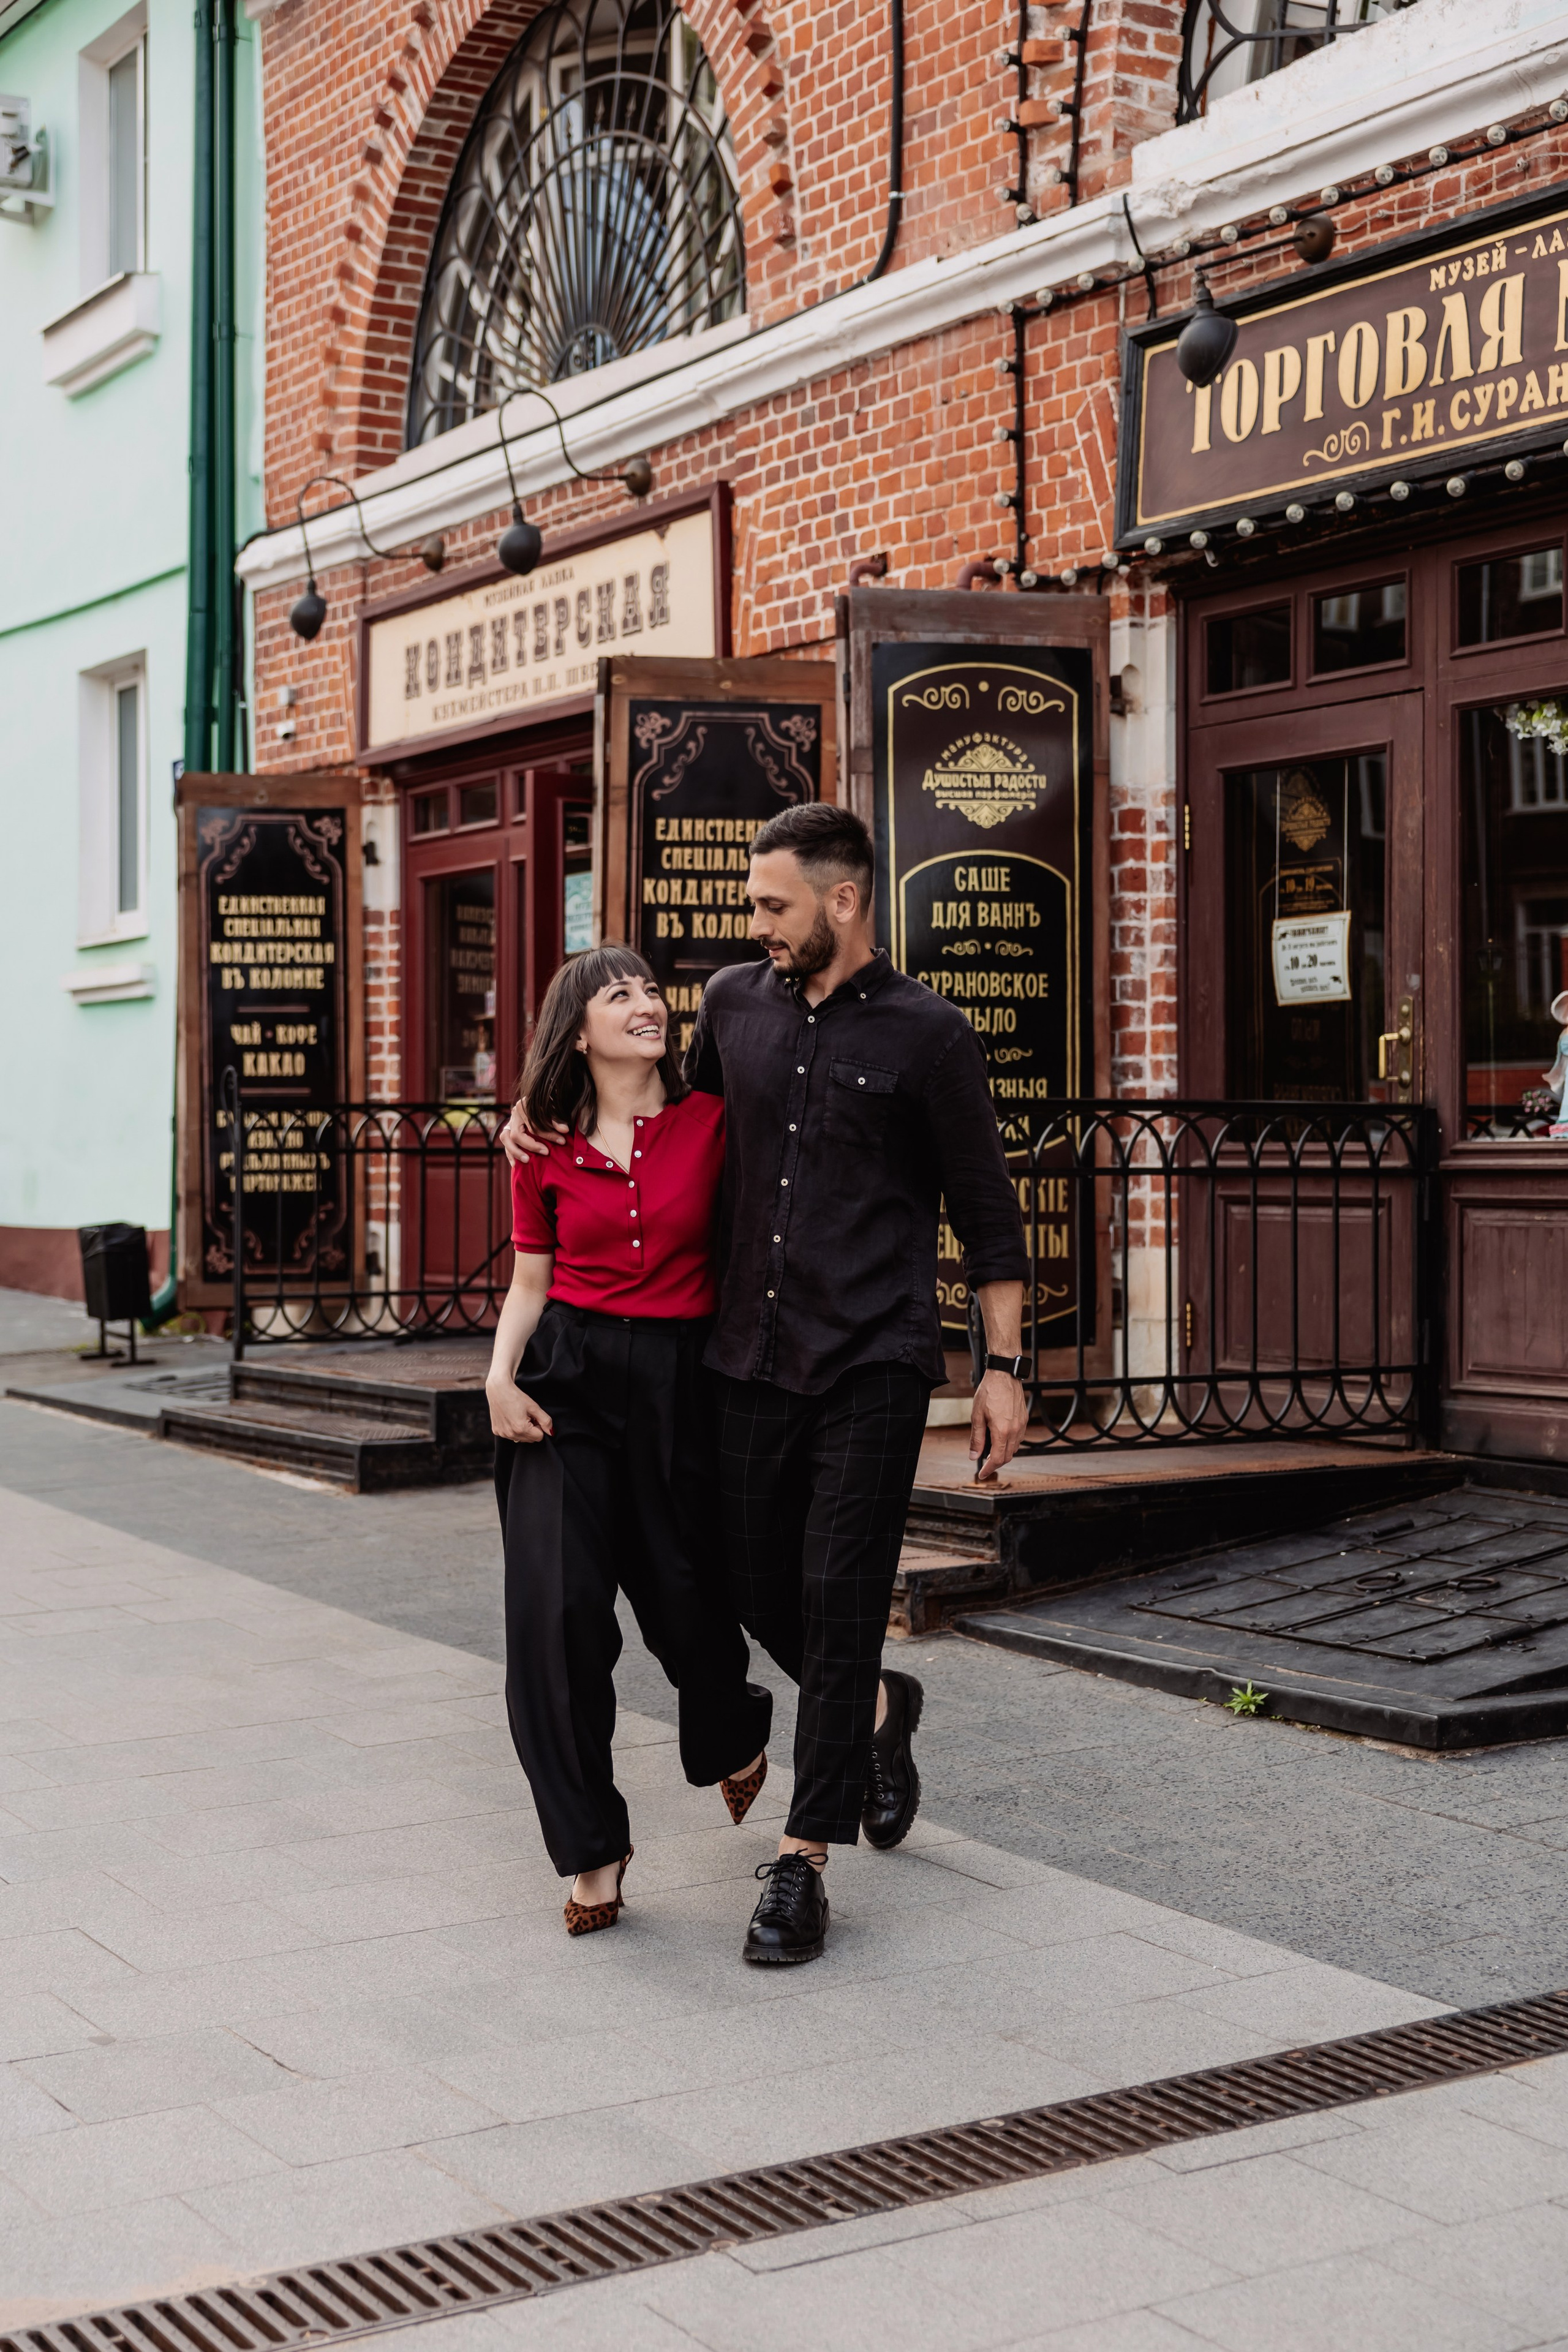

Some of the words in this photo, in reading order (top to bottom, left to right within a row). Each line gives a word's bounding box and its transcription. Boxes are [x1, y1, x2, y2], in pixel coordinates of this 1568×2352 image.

[1186, 272, 1526, 454] ТОРГОВЛЯ
[404, 560, 671, 700] КОНДИТЕРСКАЯ
[643, 878, 755, 906] КОНДИТЕР
[954, 865, 1011, 892] САШЕ
[218, 895, 326, 916] ЕДИНСТВЕННАЯ
[930, 900, 971, 930] ДЛЯ
[976, 900, 1041, 930] ВАННЪ
[655, 911, 685, 938] ВЪ
[209, 941, 335, 964] КОНДИТЕРСКАЯ
[221, 967, 245, 990] ВЪ
[665, 982, 703, 1012] ЧАЙ
[230, 1020, 262, 1045] ЧАЙ
[276, 1023, 318, 1046] КОФЕ
[243, 1051, 306, 1077] КАКАО
